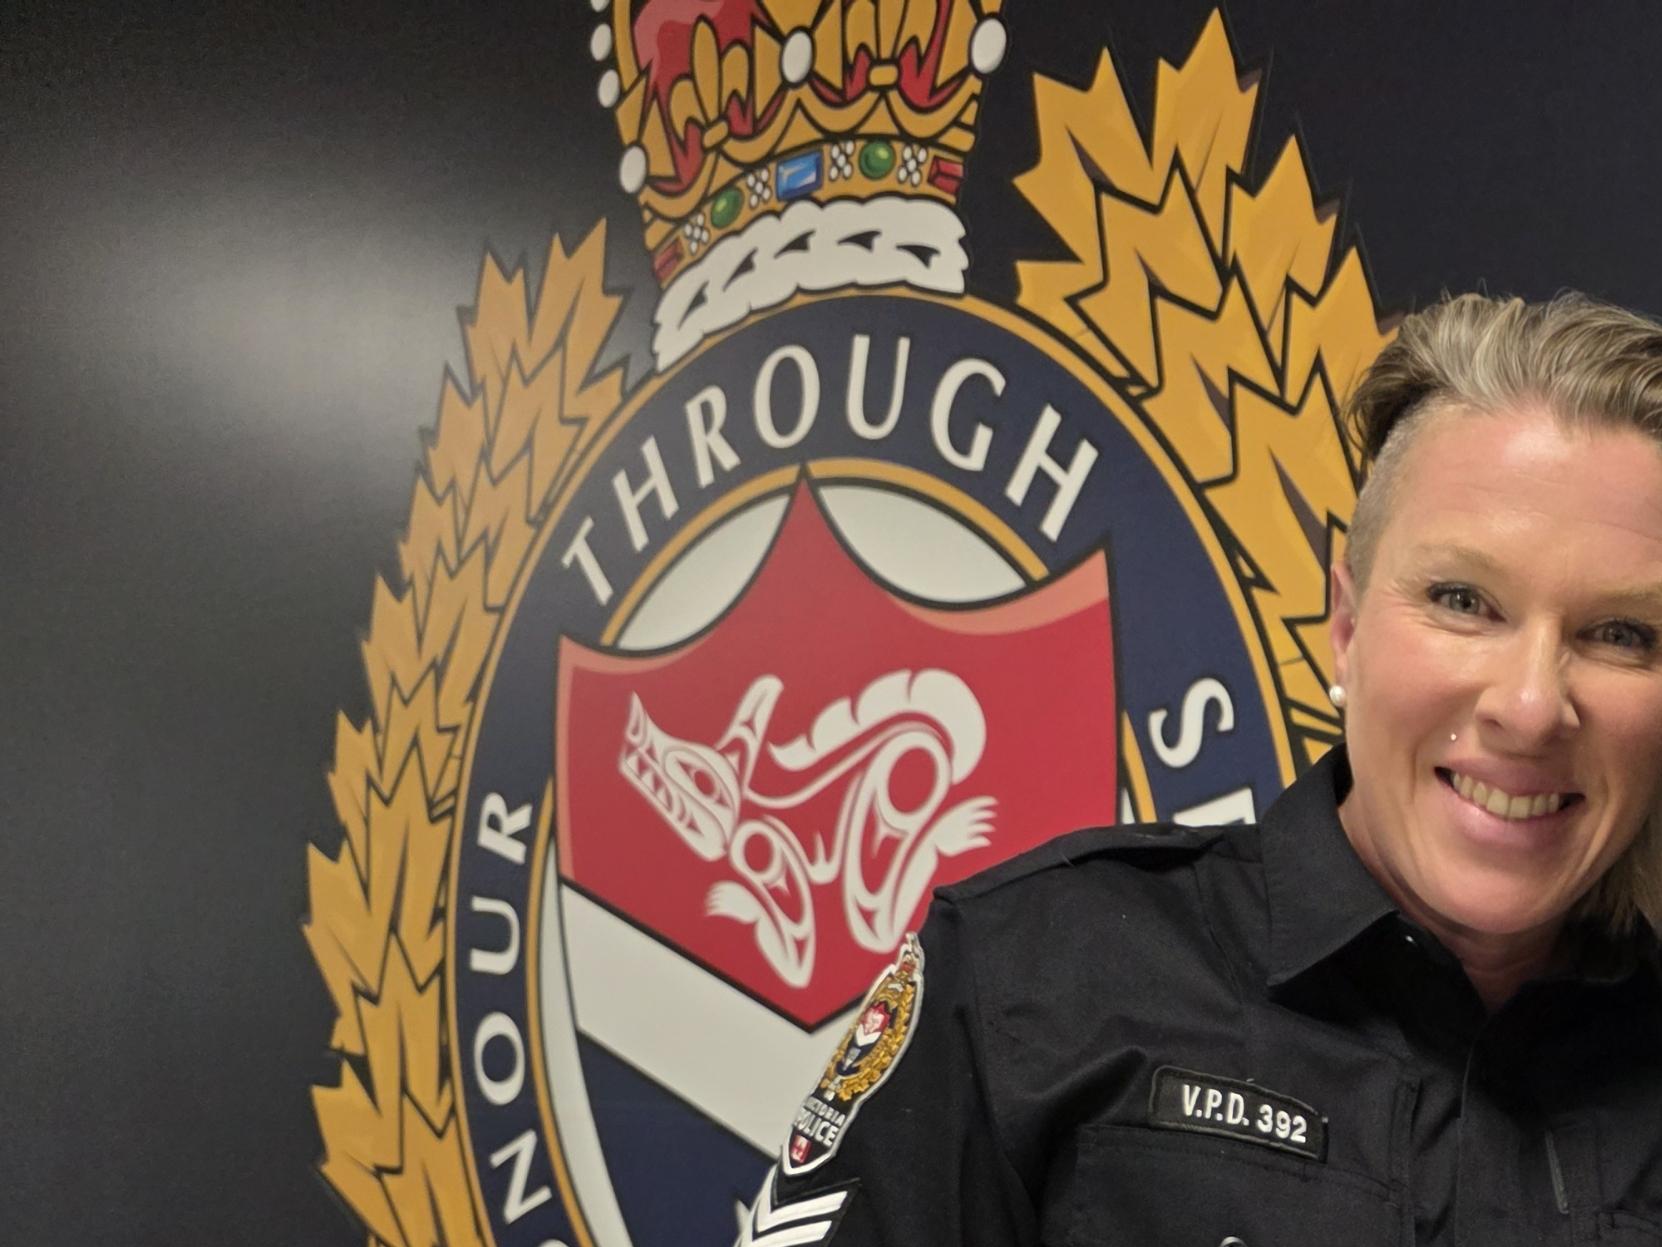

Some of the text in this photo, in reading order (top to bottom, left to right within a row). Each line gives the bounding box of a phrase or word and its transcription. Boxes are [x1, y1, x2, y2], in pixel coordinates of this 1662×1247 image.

[562, 334, 1098, 607] THROUGH
[1183, 1084, 1308, 1143] V.P.D. 392
